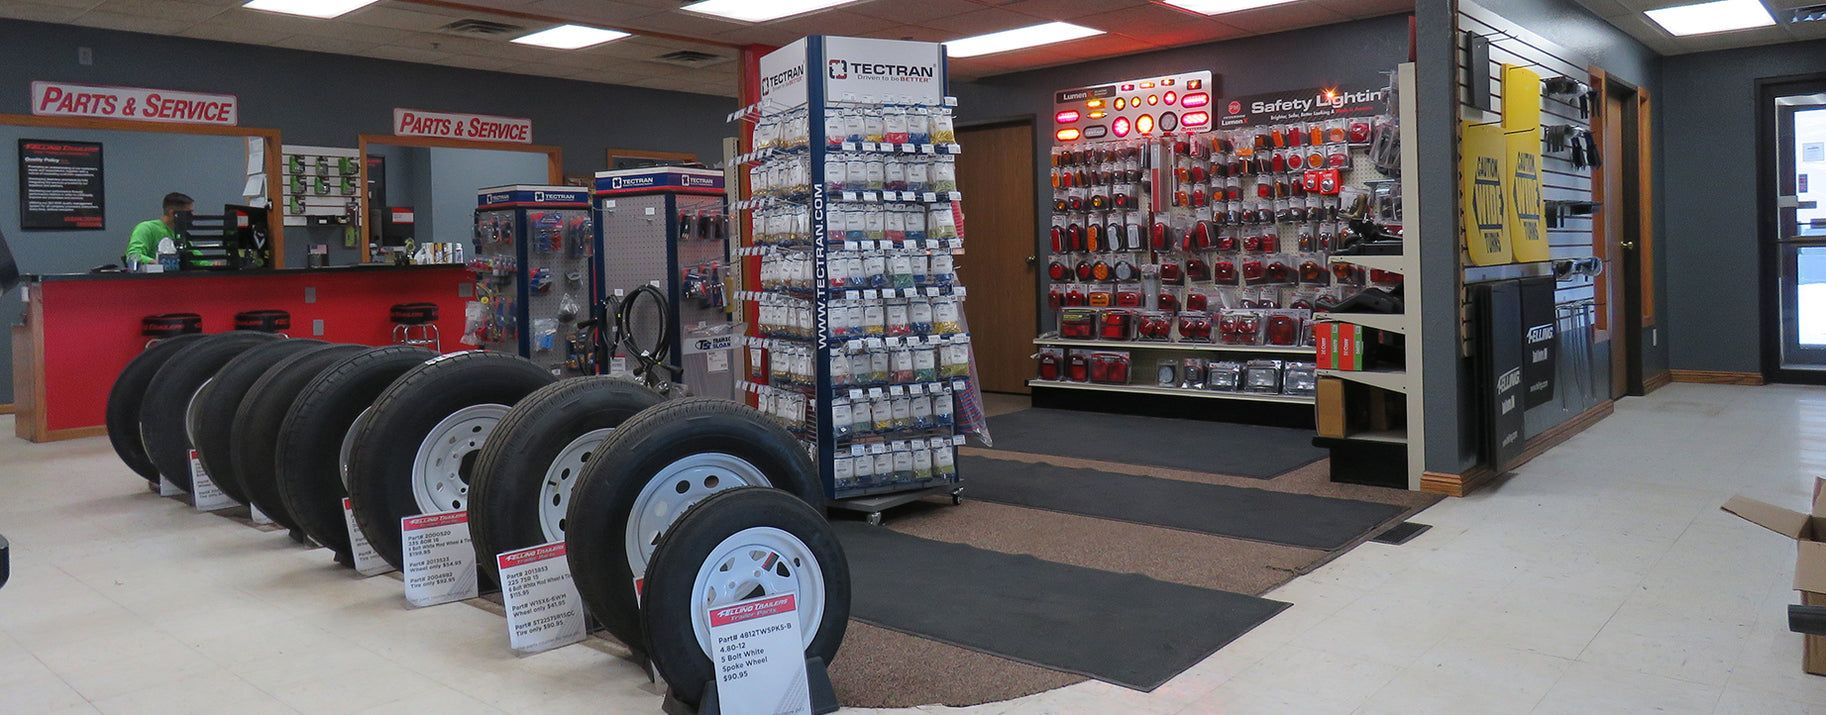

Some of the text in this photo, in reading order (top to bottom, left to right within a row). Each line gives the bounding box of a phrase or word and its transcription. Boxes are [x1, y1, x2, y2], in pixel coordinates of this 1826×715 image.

[770, 64, 804, 87] TECTRAN
[851, 62, 933, 77] TECTRAN
[40, 86, 232, 122] PARTS & SERVICE
[1251, 89, 1382, 114] Safety Lightin
[399, 112, 529, 141] PARTS & SERVICE
[813, 183, 828, 350] WWW.TECTRAN.COM
[506, 572, 523, 580] Part#
[511, 603, 529, 611] Part#
[512, 608, 532, 618] Wheel
[533, 605, 546, 613] only
[514, 621, 532, 630] Part#
[529, 626, 542, 634] only
[718, 634, 738, 644] Part#
[719, 642, 746, 653] 4.80-12
[721, 648, 765, 664] 5 Bolt White
[722, 656, 768, 673] Spoke Wheel
[723, 670, 749, 682] $90.95
